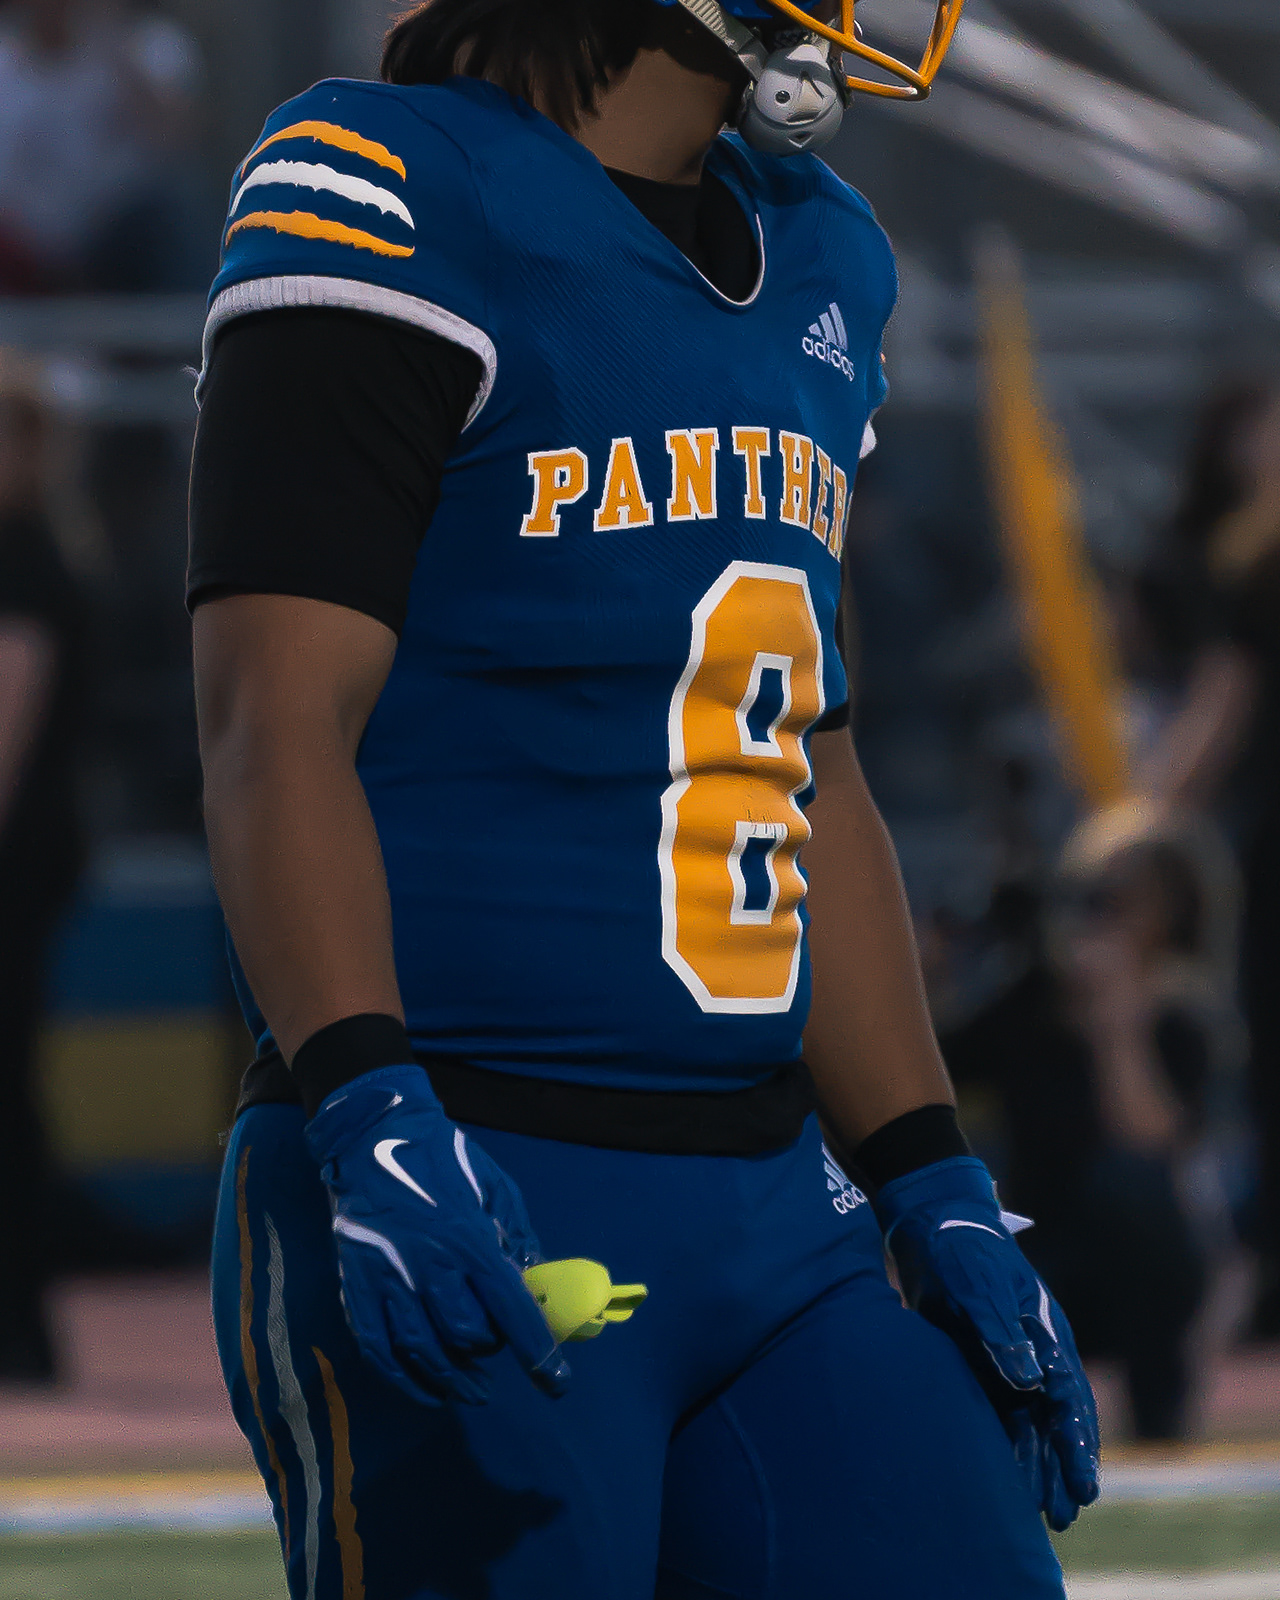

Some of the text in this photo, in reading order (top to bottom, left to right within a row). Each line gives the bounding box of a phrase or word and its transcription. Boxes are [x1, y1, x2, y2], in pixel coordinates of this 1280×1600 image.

[802, 336, 855, 382] adidas
[519, 425, 852, 563] PANTHER
[658, 559, 825, 1014] 8
